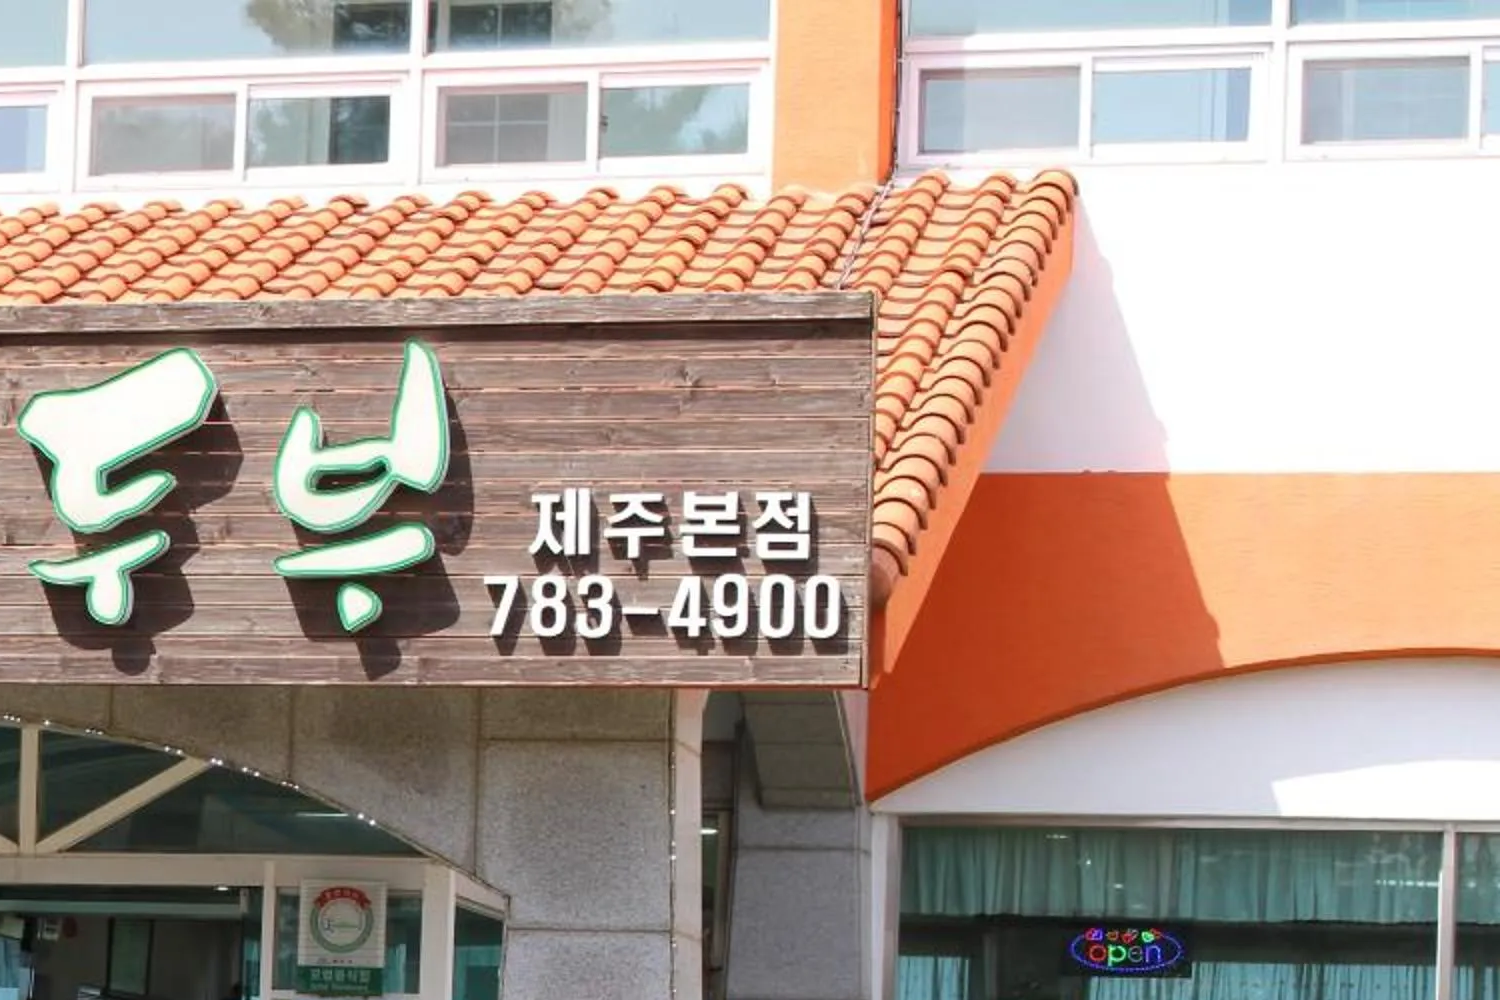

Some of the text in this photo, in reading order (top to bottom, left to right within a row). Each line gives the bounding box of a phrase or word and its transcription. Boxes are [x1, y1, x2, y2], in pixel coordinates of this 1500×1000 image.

[529, 487, 813, 561] 제주본점
[480, 573, 843, 639] 783-4900
[1088, 944, 1161, 966] open
